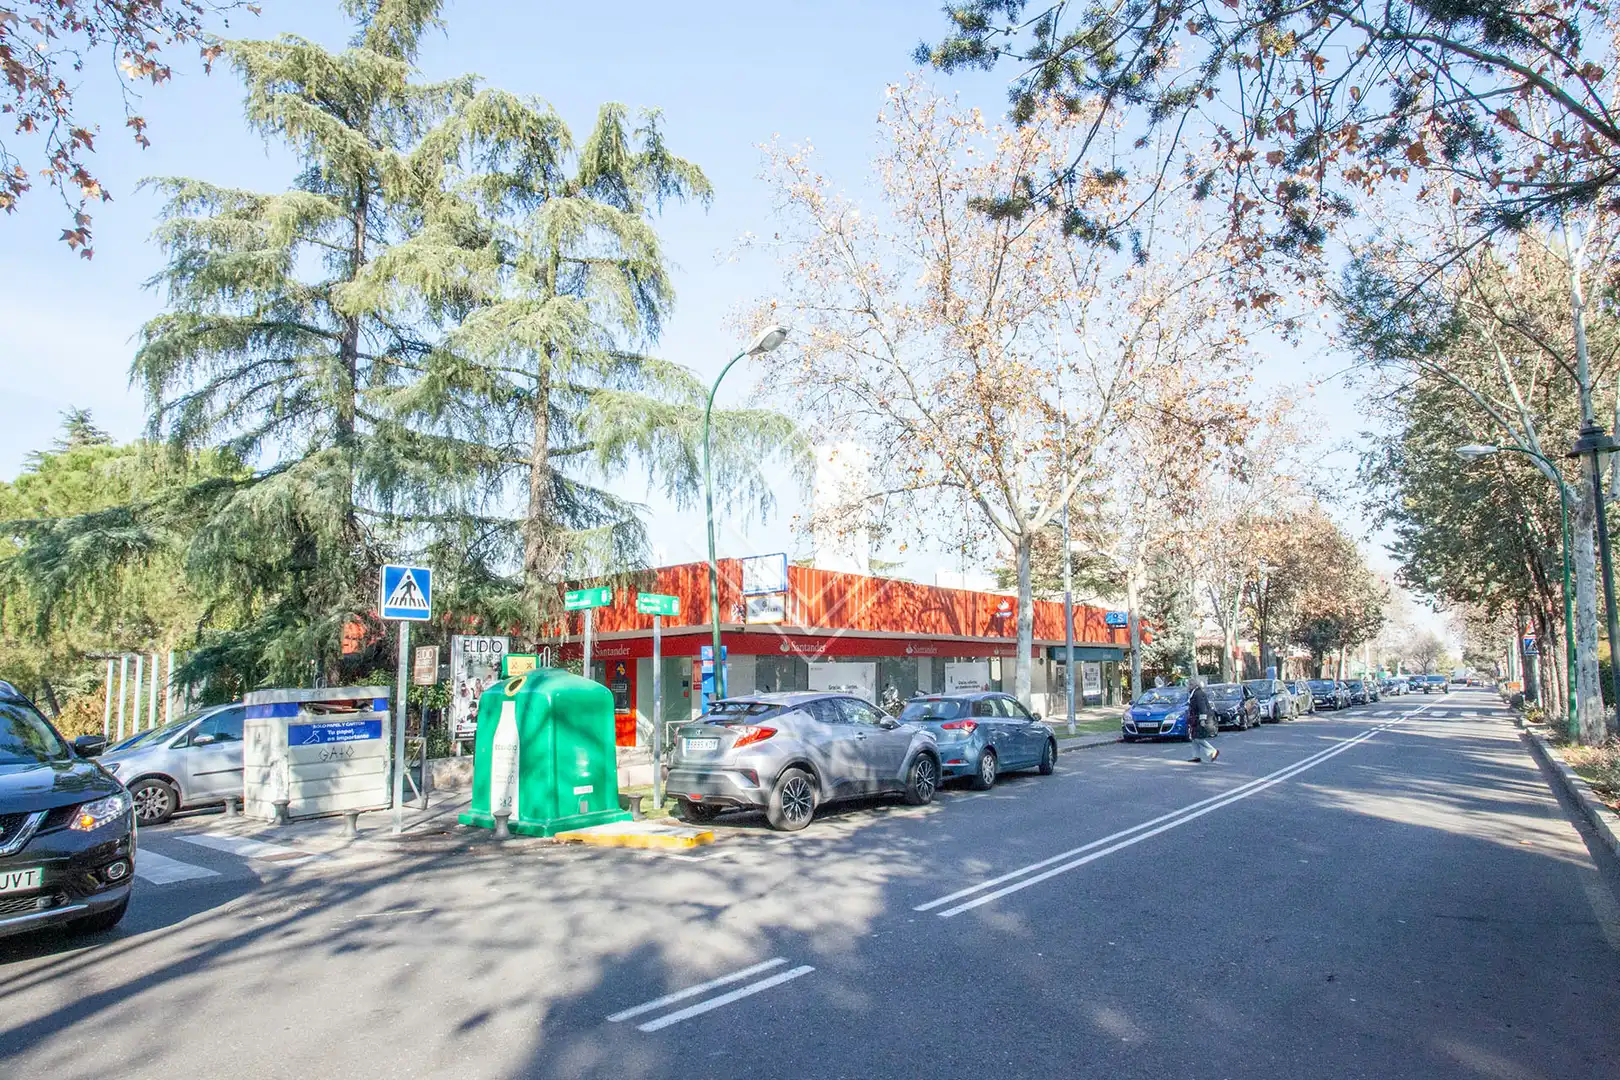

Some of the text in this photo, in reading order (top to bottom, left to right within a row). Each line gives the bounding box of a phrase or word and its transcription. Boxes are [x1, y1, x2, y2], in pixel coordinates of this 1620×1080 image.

[463, 640, 503, 654] ELIDIO
[595, 643, 630, 657] Santander
[791, 641, 826, 652] Santander
[336, 733, 369, 741] importante
